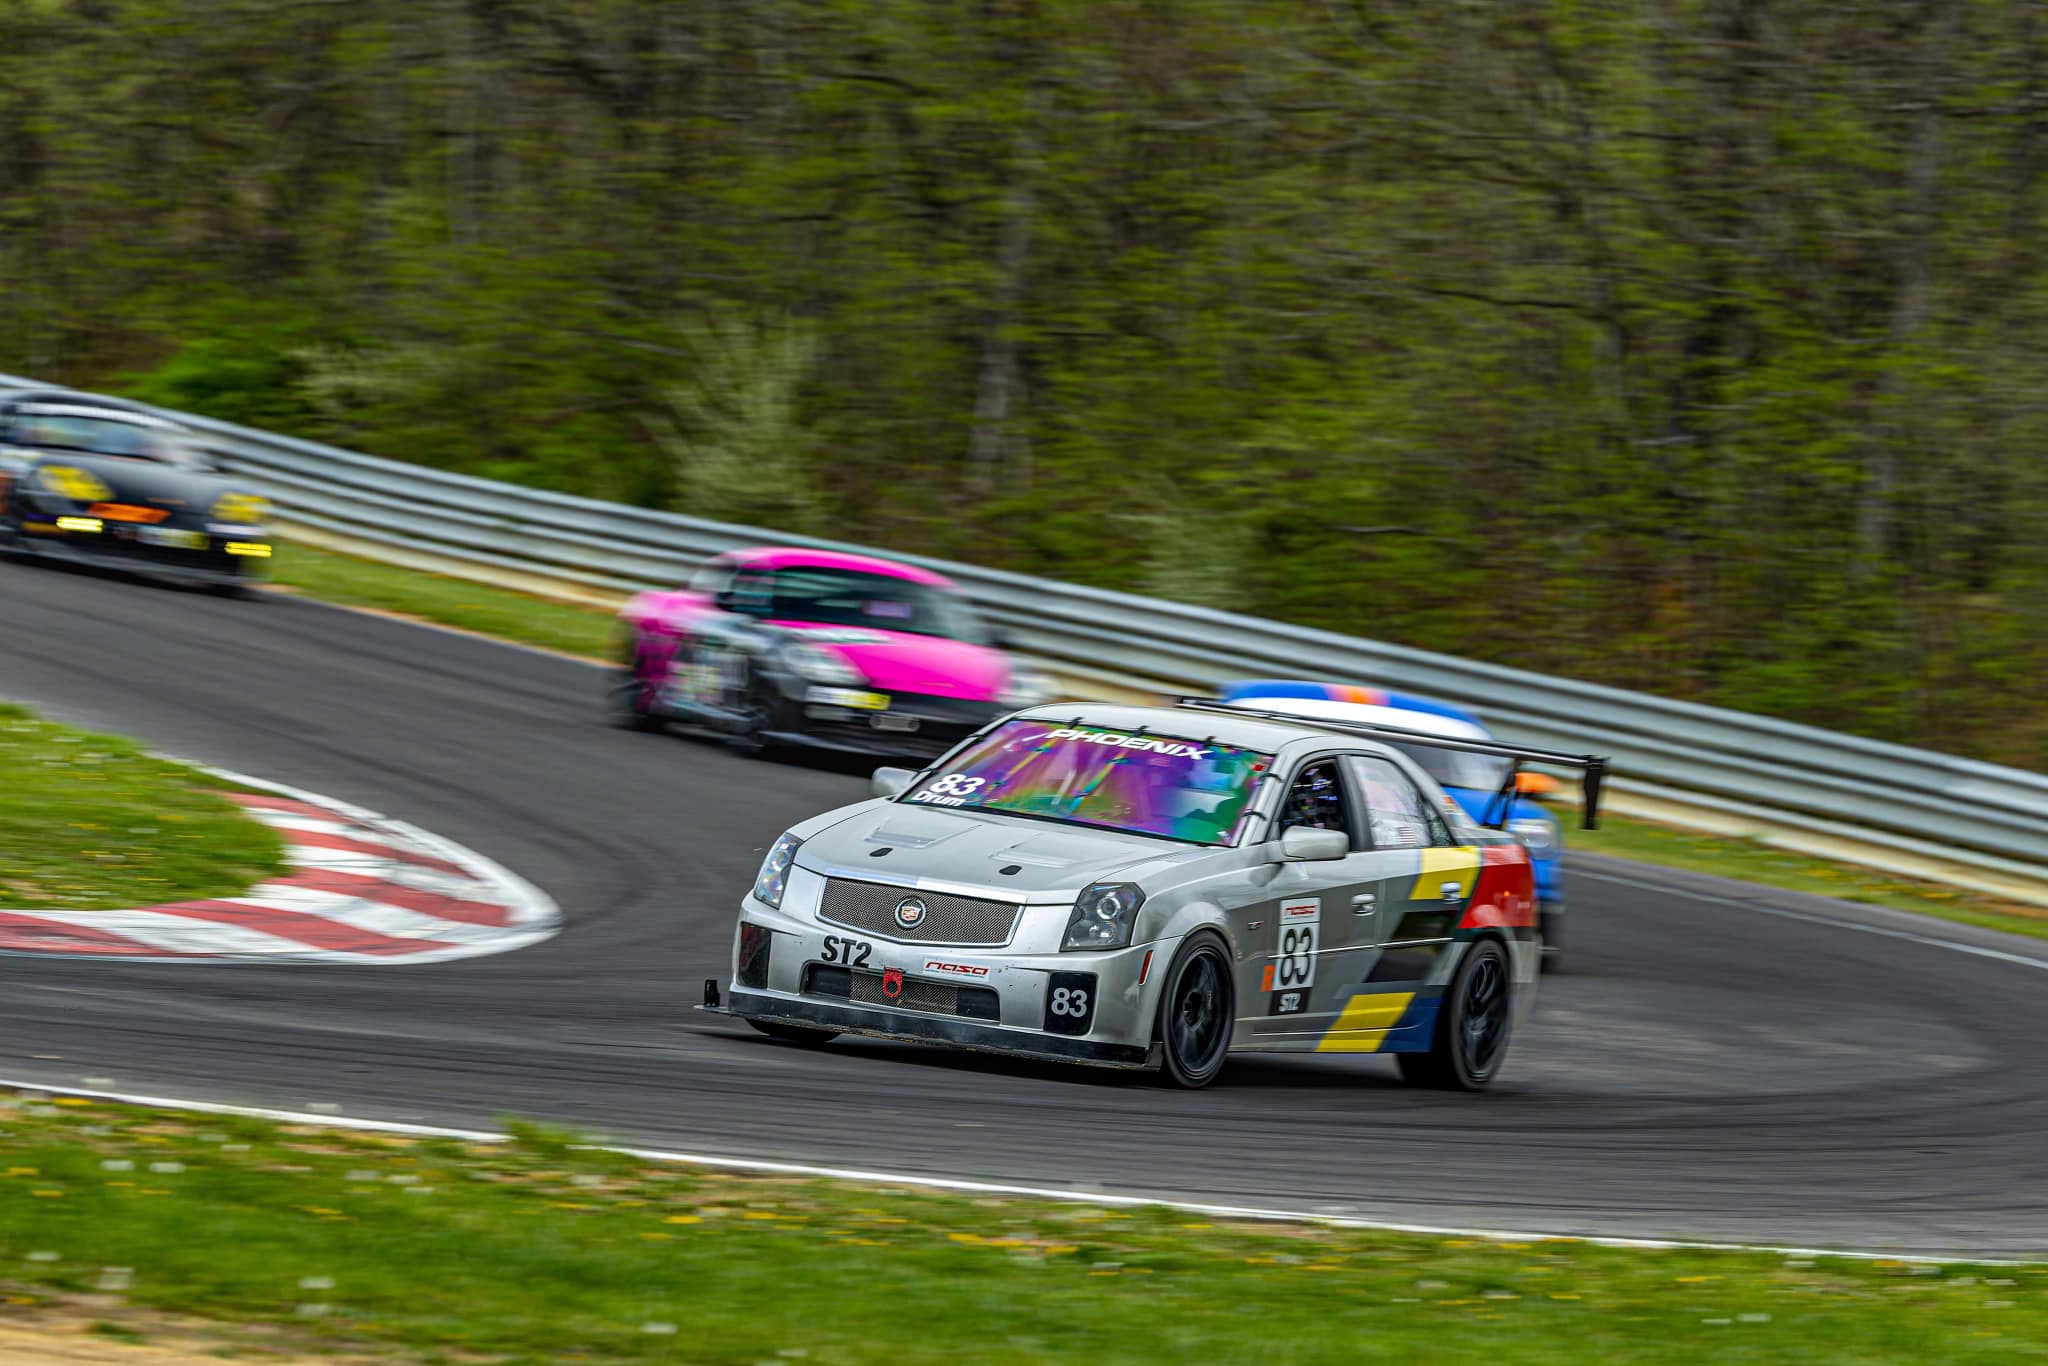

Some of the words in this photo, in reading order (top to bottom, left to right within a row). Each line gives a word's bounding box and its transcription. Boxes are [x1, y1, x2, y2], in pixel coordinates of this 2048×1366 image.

[1045, 728, 1214, 760] PHOENIX
[911, 790, 966, 807] Drum
[930, 774, 986, 796] 83
[821, 935, 872, 968] ST2
[1281, 927, 1312, 986] 83
[925, 961, 989, 976] nasa
[1051, 987, 1088, 1018] 83
